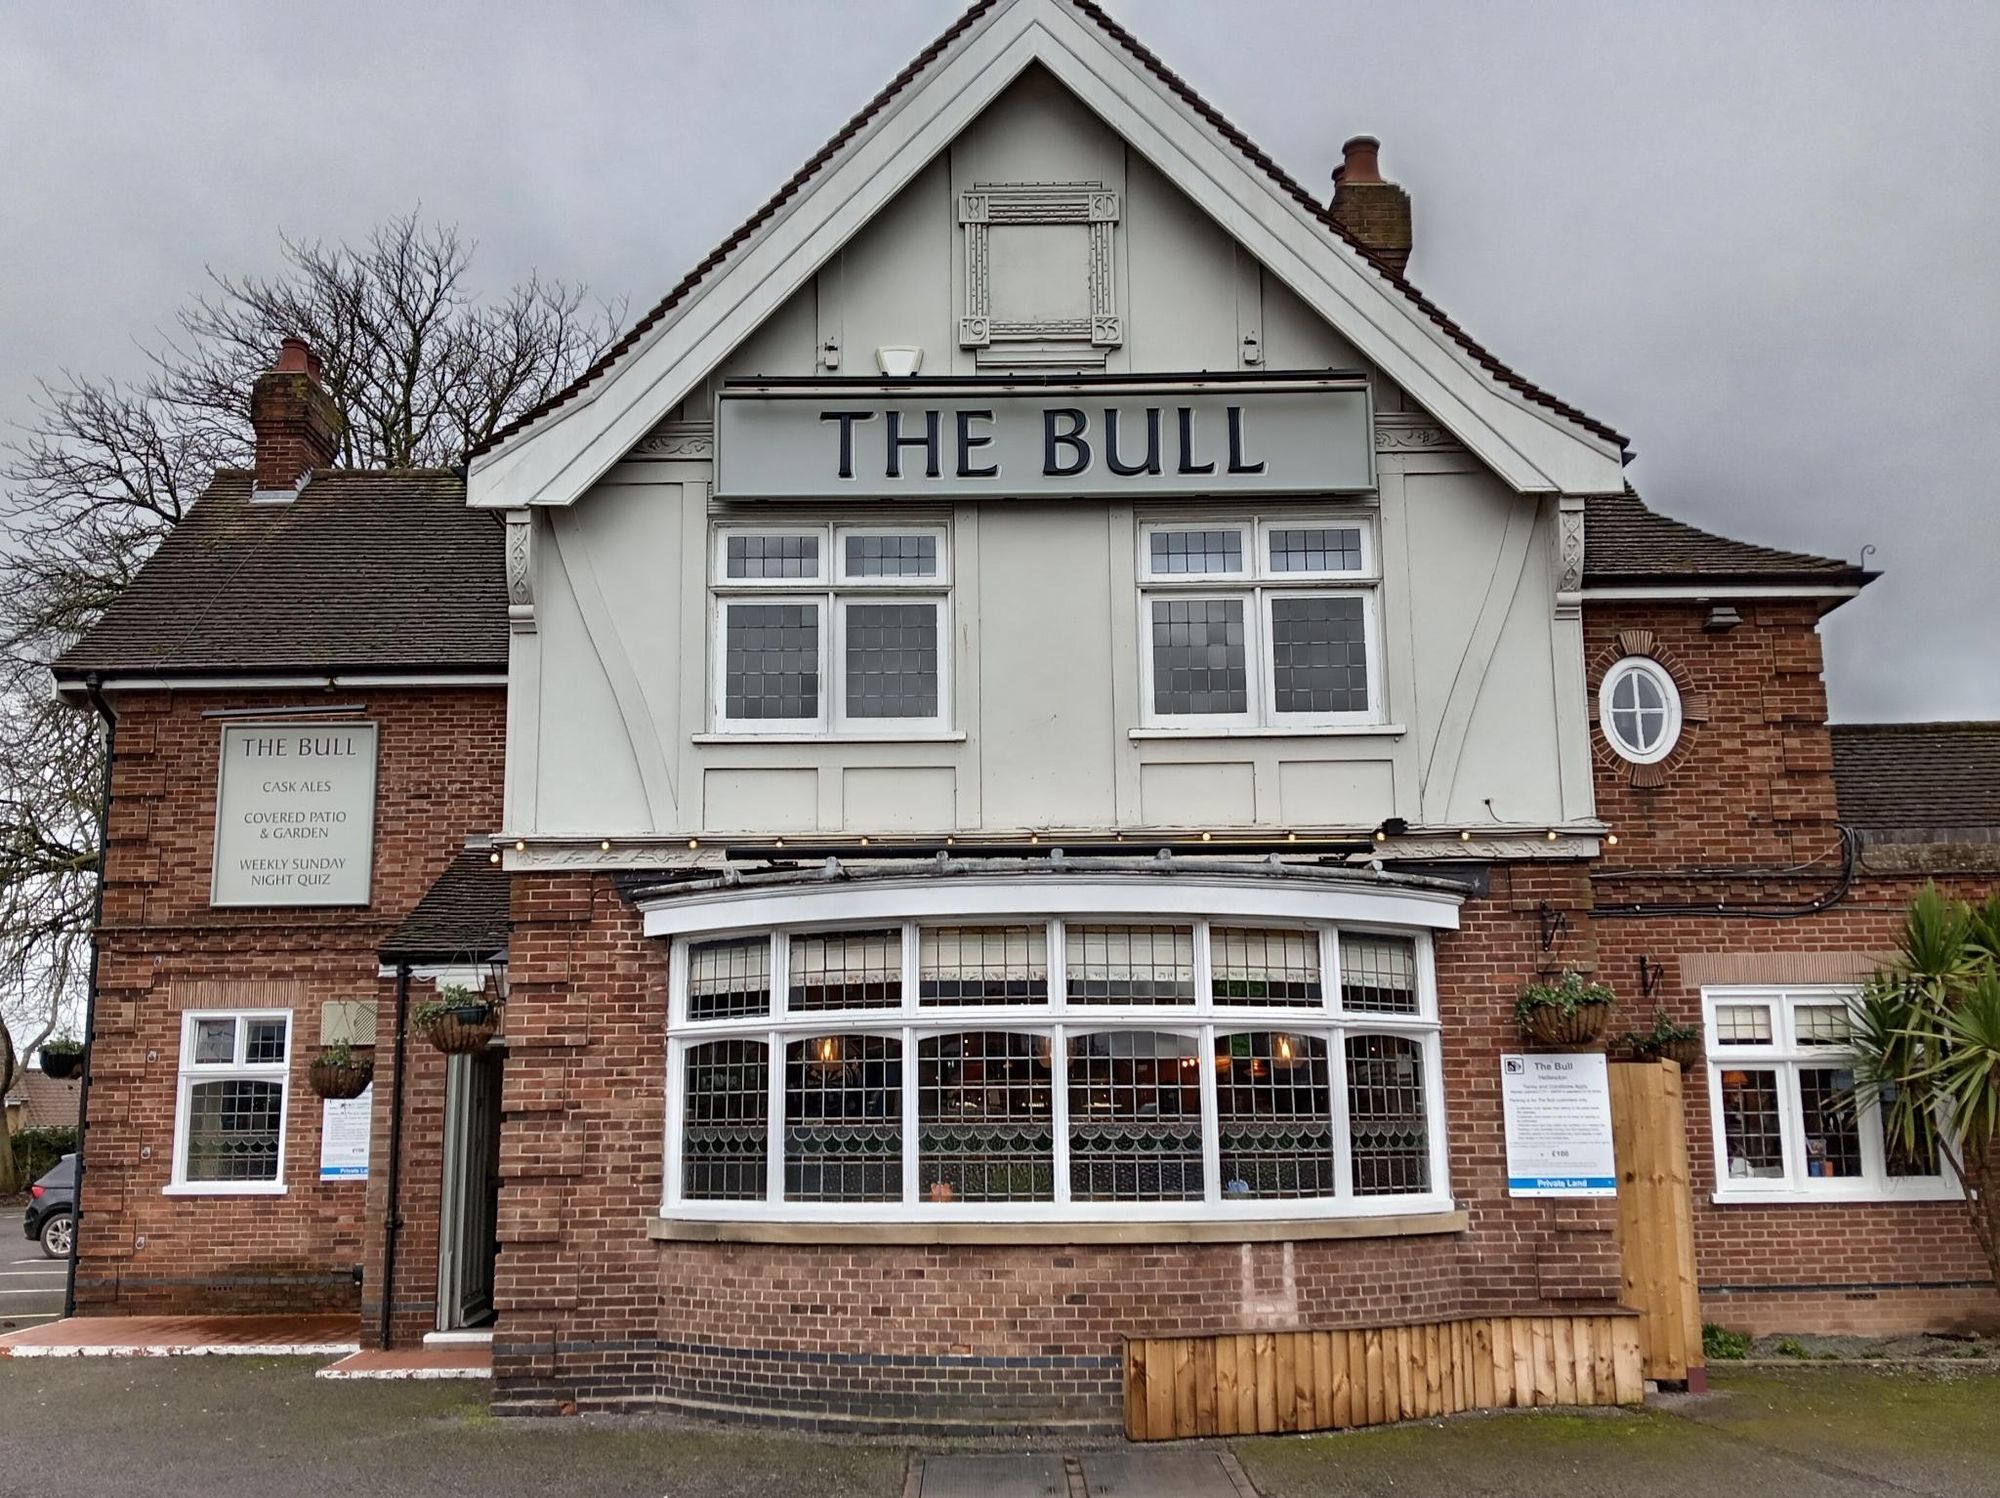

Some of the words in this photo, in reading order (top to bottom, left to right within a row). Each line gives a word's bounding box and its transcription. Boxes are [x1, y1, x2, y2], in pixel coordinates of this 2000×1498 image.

[962, 318, 986, 344] 19
[820, 409, 998, 479] THE
[1042, 406, 1265, 477] BULL
[242, 738, 287, 757] THE
[299, 737, 356, 756] BULL
[262, 781, 297, 793] CASK
[300, 781, 332, 792] ALES
[244, 812, 306, 824] COVERED
[309, 811, 347, 823] PATIO
[259, 828, 269, 839] &
[273, 827, 329, 839] GARDEN
[239, 859, 289, 871] WEEKLY
[292, 858, 346, 870] SUNDAY
[251, 874, 293, 886] NIGHT
[297, 873, 331, 887] QUIZ
[1534, 1062, 1552, 1071] The
[1554, 1062, 1573, 1071] Bull
[1537, 1178, 1565, 1188] Private
[1567, 1178, 1588, 1187] Land
